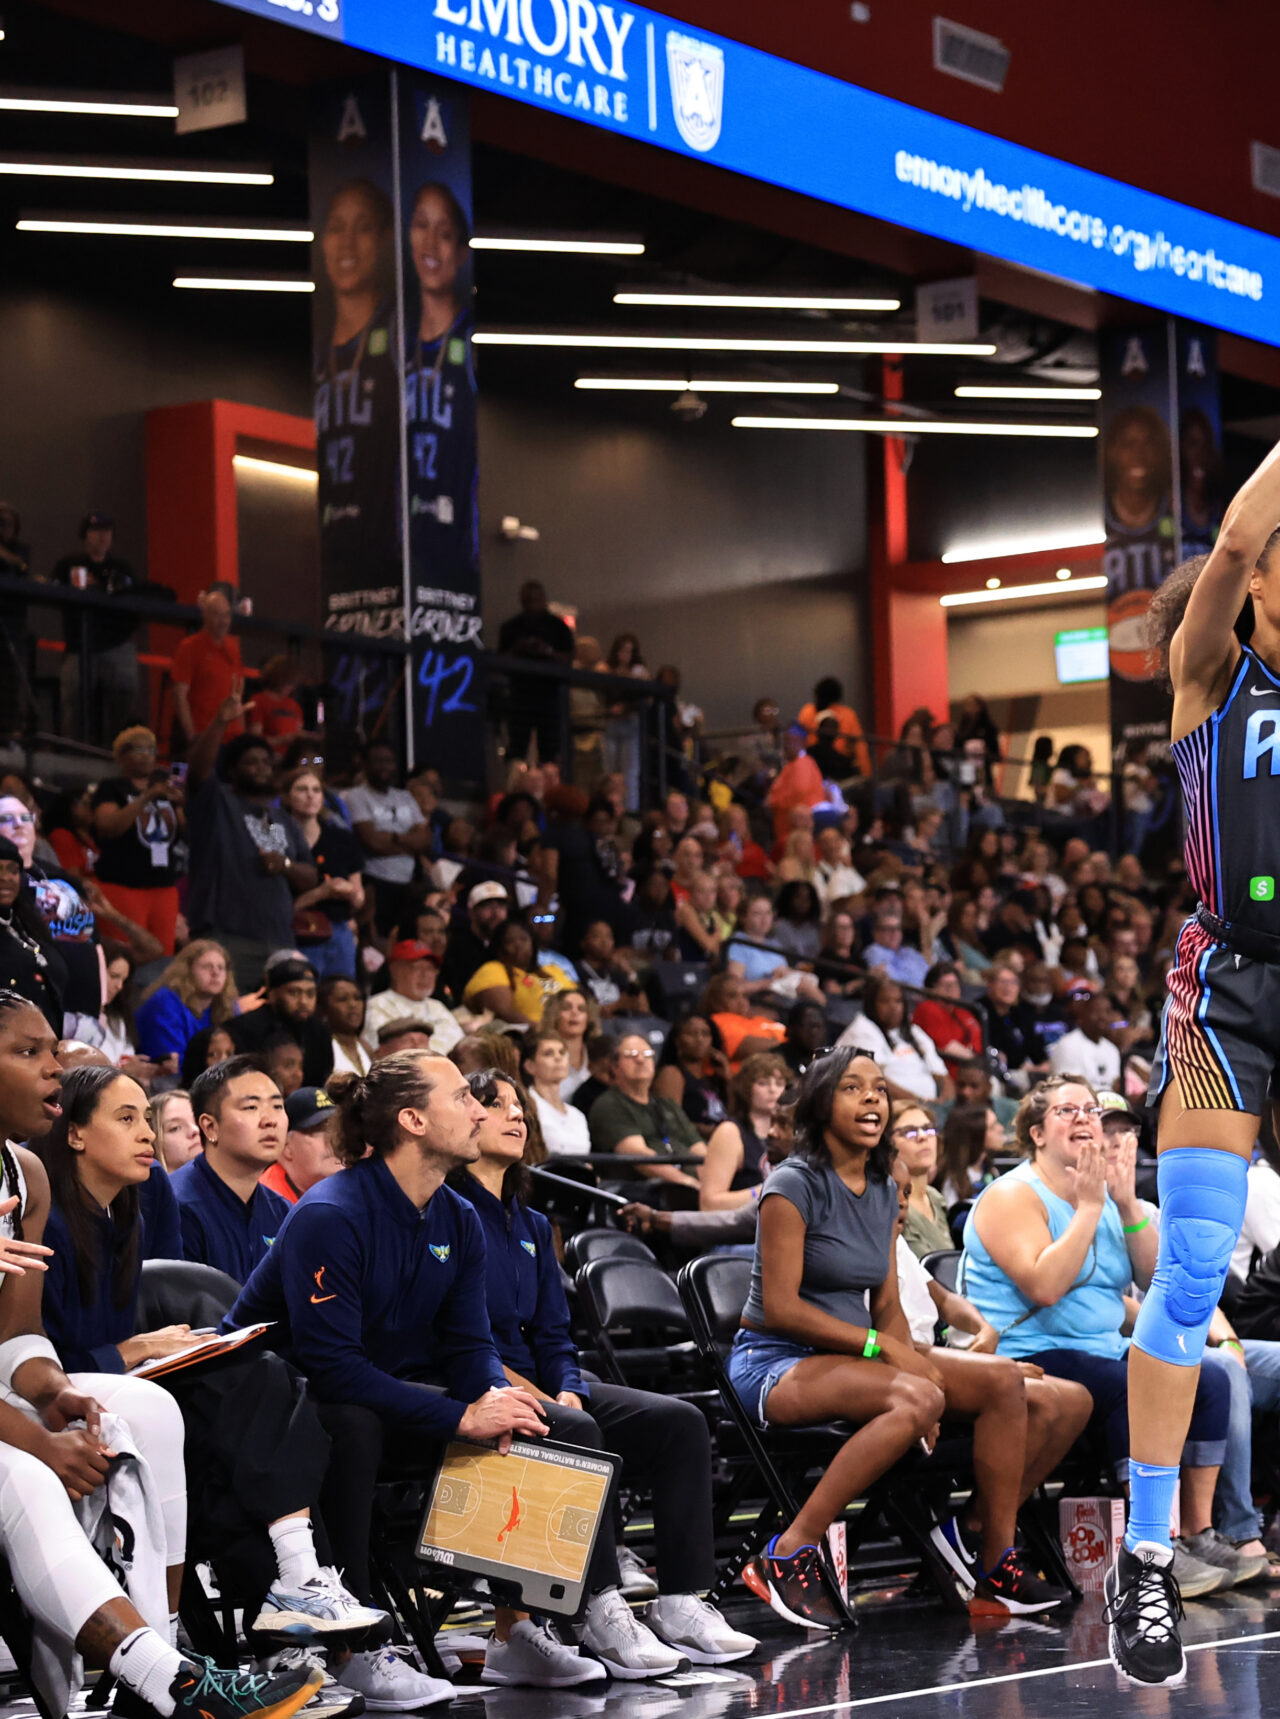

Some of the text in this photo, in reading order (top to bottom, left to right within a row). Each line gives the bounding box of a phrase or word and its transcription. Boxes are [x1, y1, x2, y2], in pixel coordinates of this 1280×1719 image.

[435, 31, 629, 122] HEALTHCARE
[413, 431, 438, 480] 42
[418, 650, 478, 727] 42
[541, 1451, 575, 1466] NATIONAL
[575, 1459, 610, 1474] WOMEN'S
[1069, 1526, 1095, 1547] POP
[420, 1545, 455, 1566] Wilson
[1072, 1541, 1104, 1564] CORN
